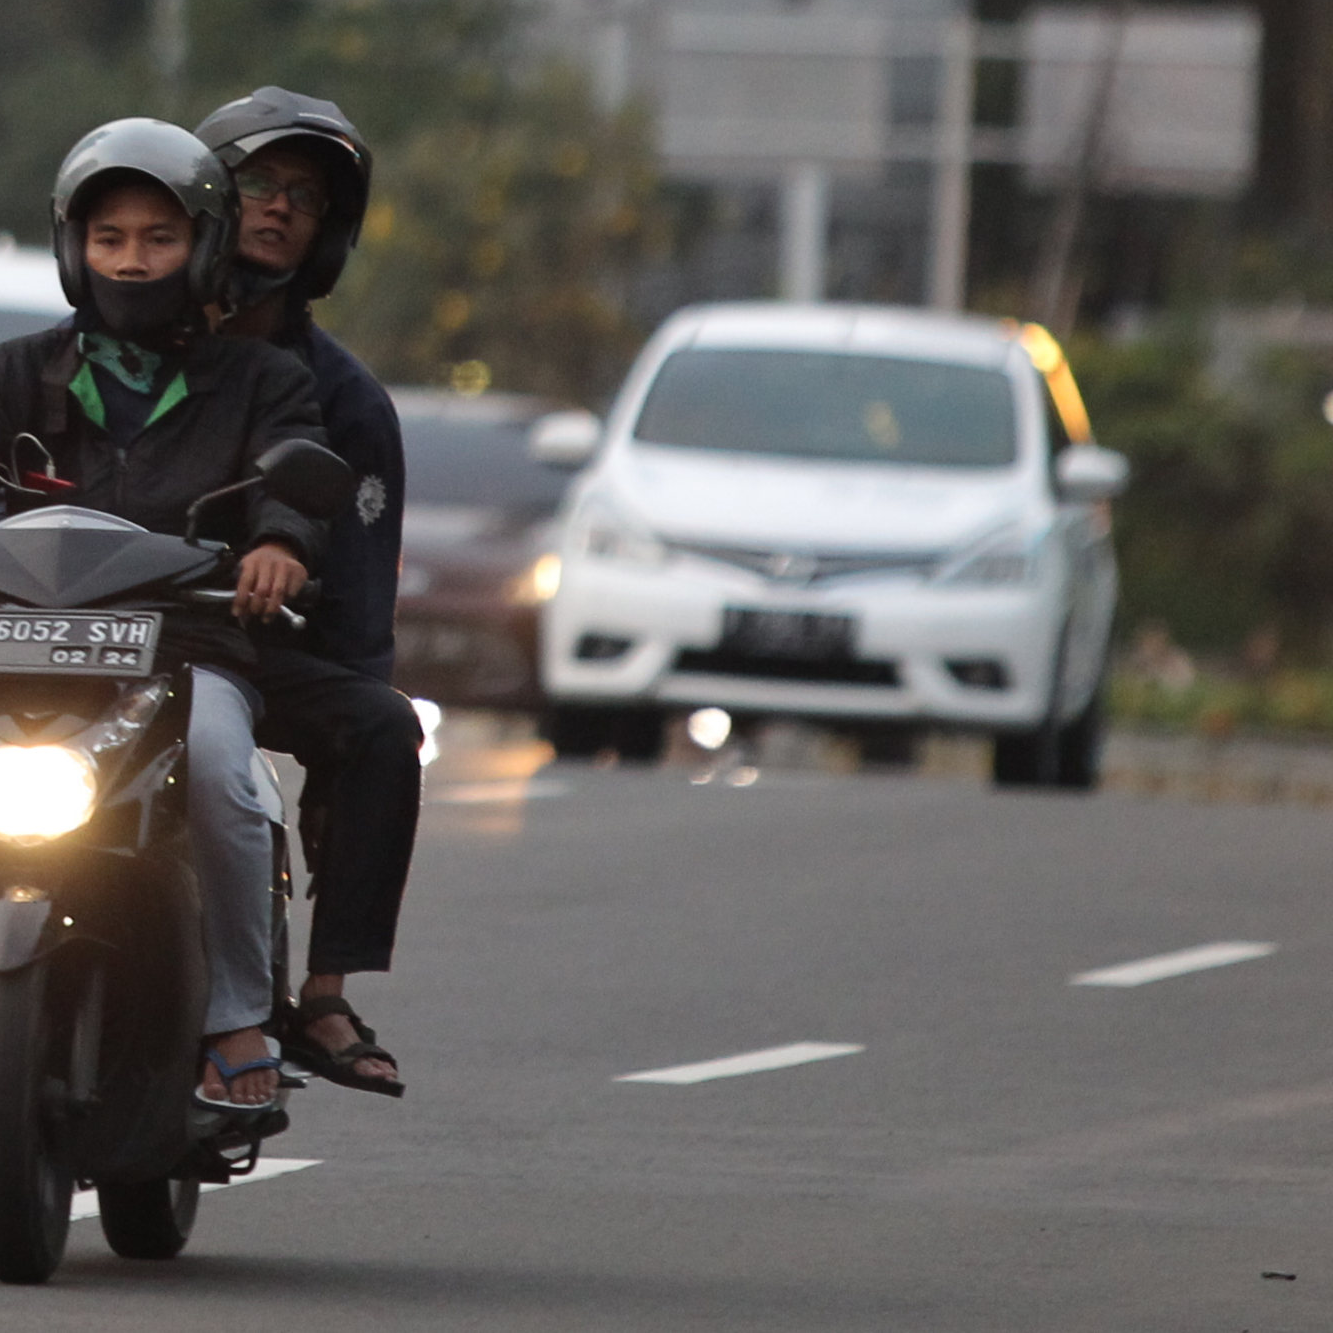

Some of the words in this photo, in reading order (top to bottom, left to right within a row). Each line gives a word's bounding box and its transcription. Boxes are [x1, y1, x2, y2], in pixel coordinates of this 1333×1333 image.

[87, 621, 148, 644] SVH
[52, 650, 87, 664] 02
[104, 651, 137, 665] 24
